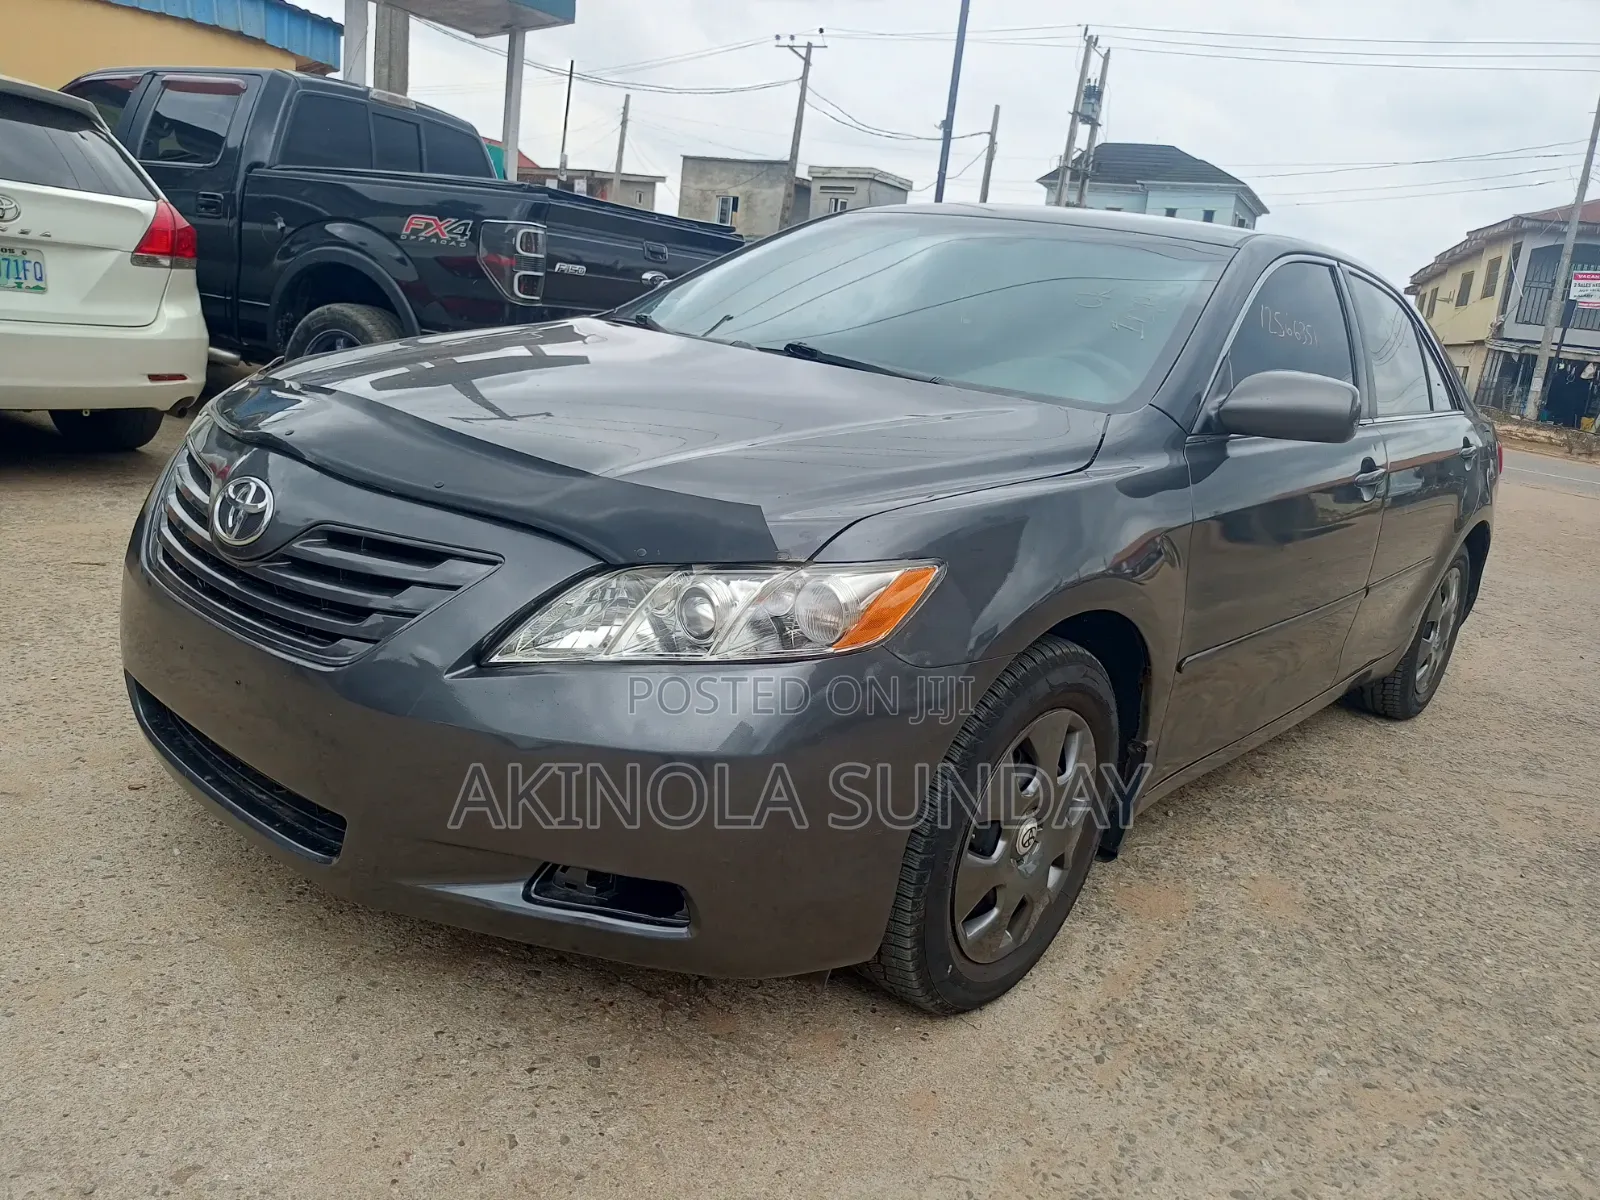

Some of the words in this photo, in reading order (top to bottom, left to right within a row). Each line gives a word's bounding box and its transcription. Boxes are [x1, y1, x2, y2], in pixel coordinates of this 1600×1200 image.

[402, 214, 474, 241] FX4
[430, 238, 467, 247] ROAD
[0, 258, 43, 281] 71FQ
